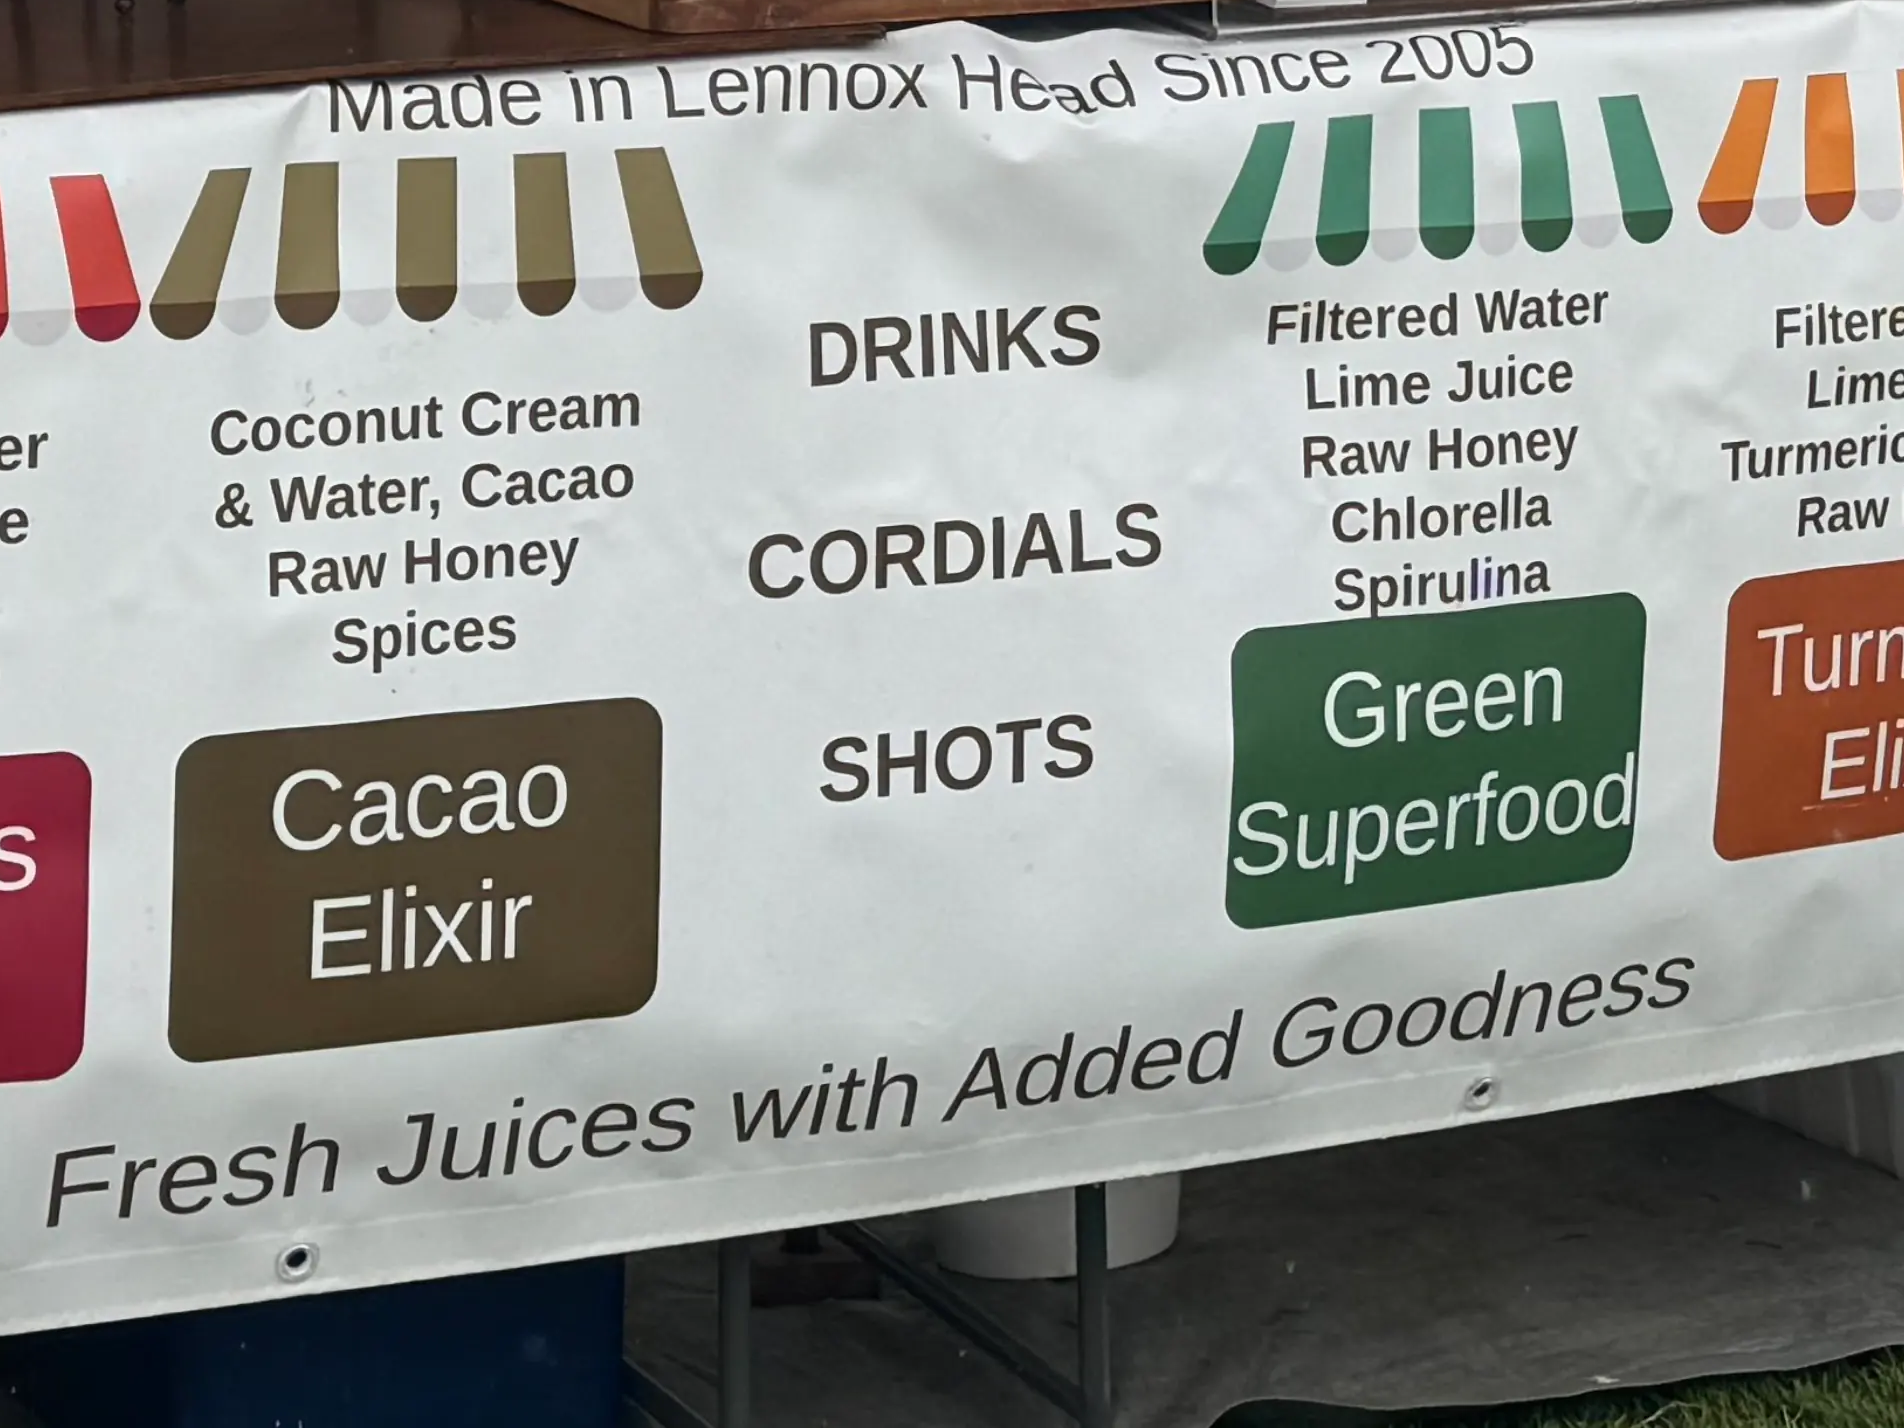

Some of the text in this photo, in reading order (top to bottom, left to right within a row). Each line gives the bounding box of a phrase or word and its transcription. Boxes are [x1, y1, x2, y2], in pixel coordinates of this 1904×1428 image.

[328, 26, 1534, 133] Made in Lennox Head Since 2005
[810, 305, 1100, 387] DRINKS
[211, 392, 639, 455] Coconut Cream
[216, 463, 633, 528] & Water, Cacao
[270, 537, 579, 597] Raw Honey
[749, 503, 1161, 598] CORDIALS
[333, 610, 516, 673] Spices
[1325, 667, 1562, 747] Green
[820, 715, 1093, 802] SHOTS
[273, 765, 567, 850] Cacao
[1233, 752, 1635, 885] Superfood
[311, 878, 532, 979] Elixir
[47, 958, 1695, 1227] Fresh Juices with Added Goodness
